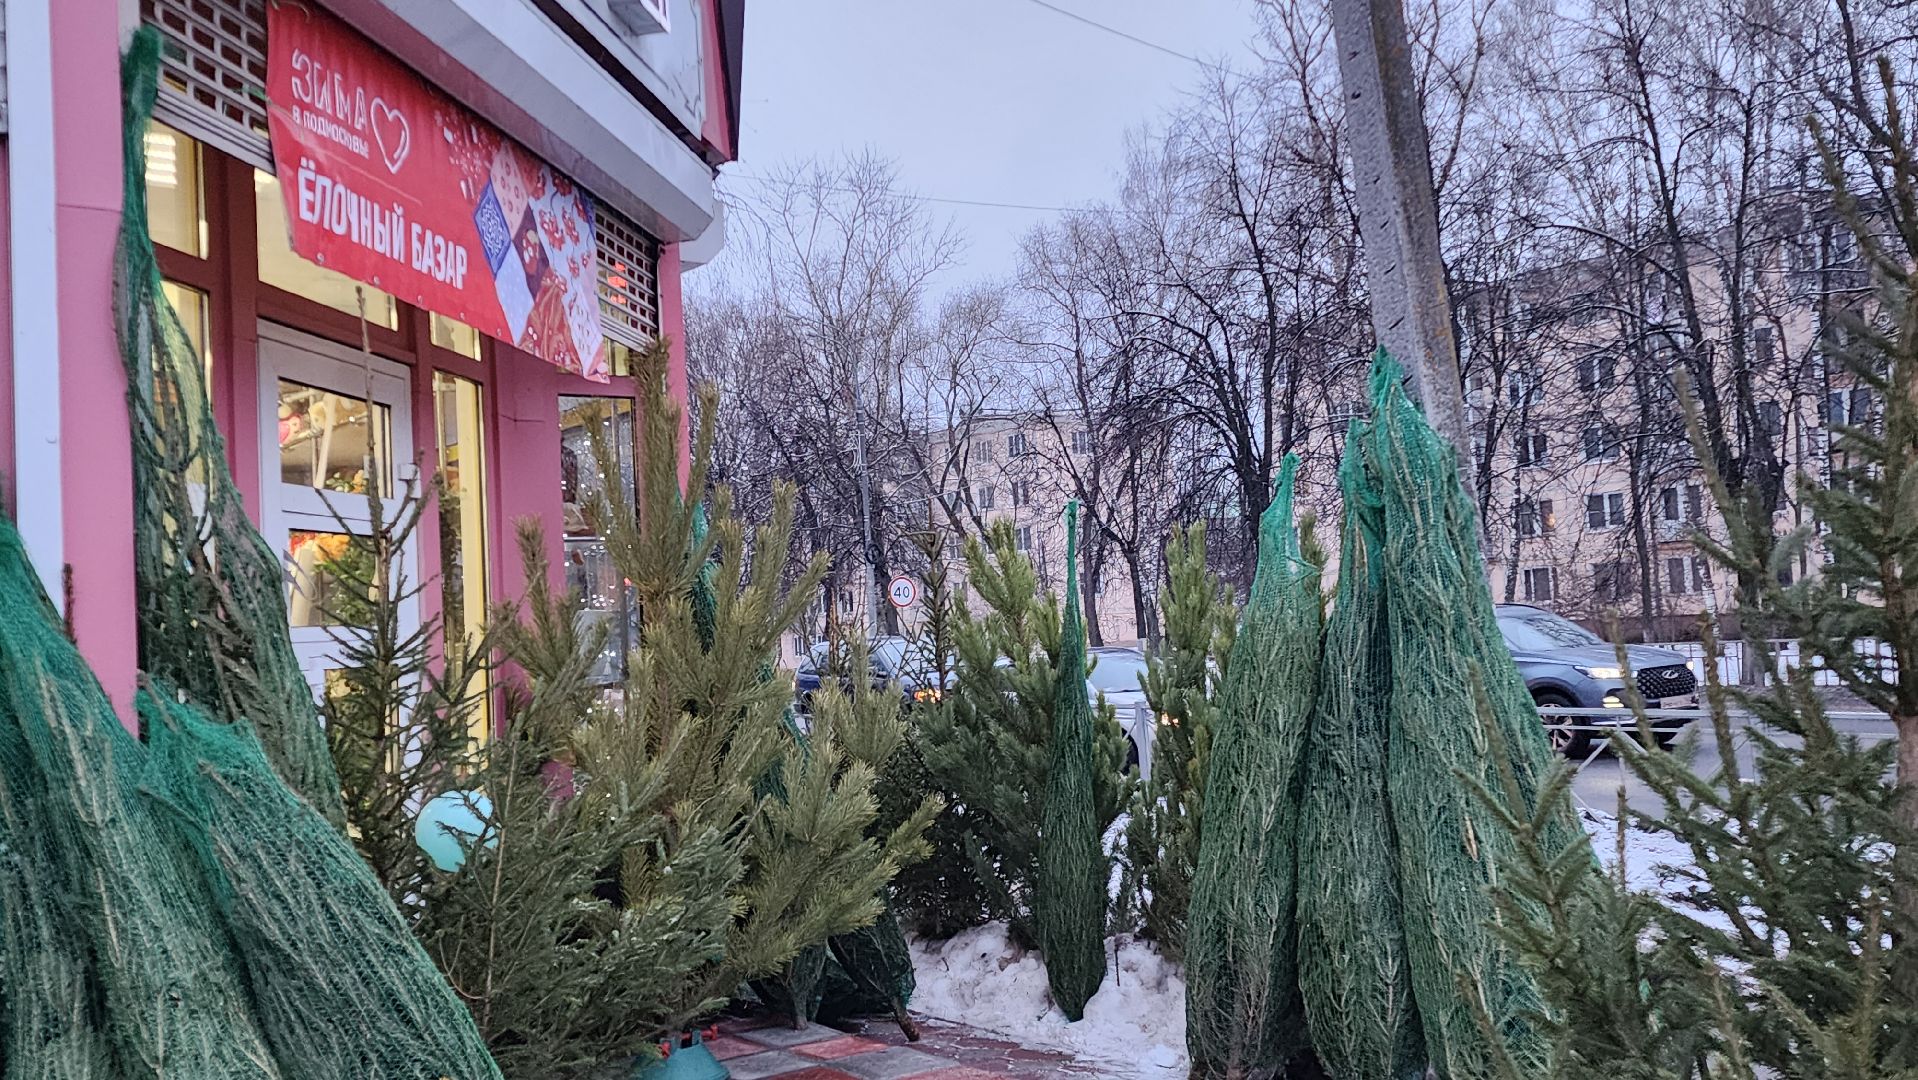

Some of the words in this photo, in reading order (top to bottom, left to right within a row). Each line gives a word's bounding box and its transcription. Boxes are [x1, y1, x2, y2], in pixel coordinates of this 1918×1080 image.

[291, 48, 368, 134] ЗИМА
[297, 156, 405, 264] ЁЛОЧНЫЙ
[411, 222, 467, 290] БАЗАР
[893, 586, 910, 598] 40
